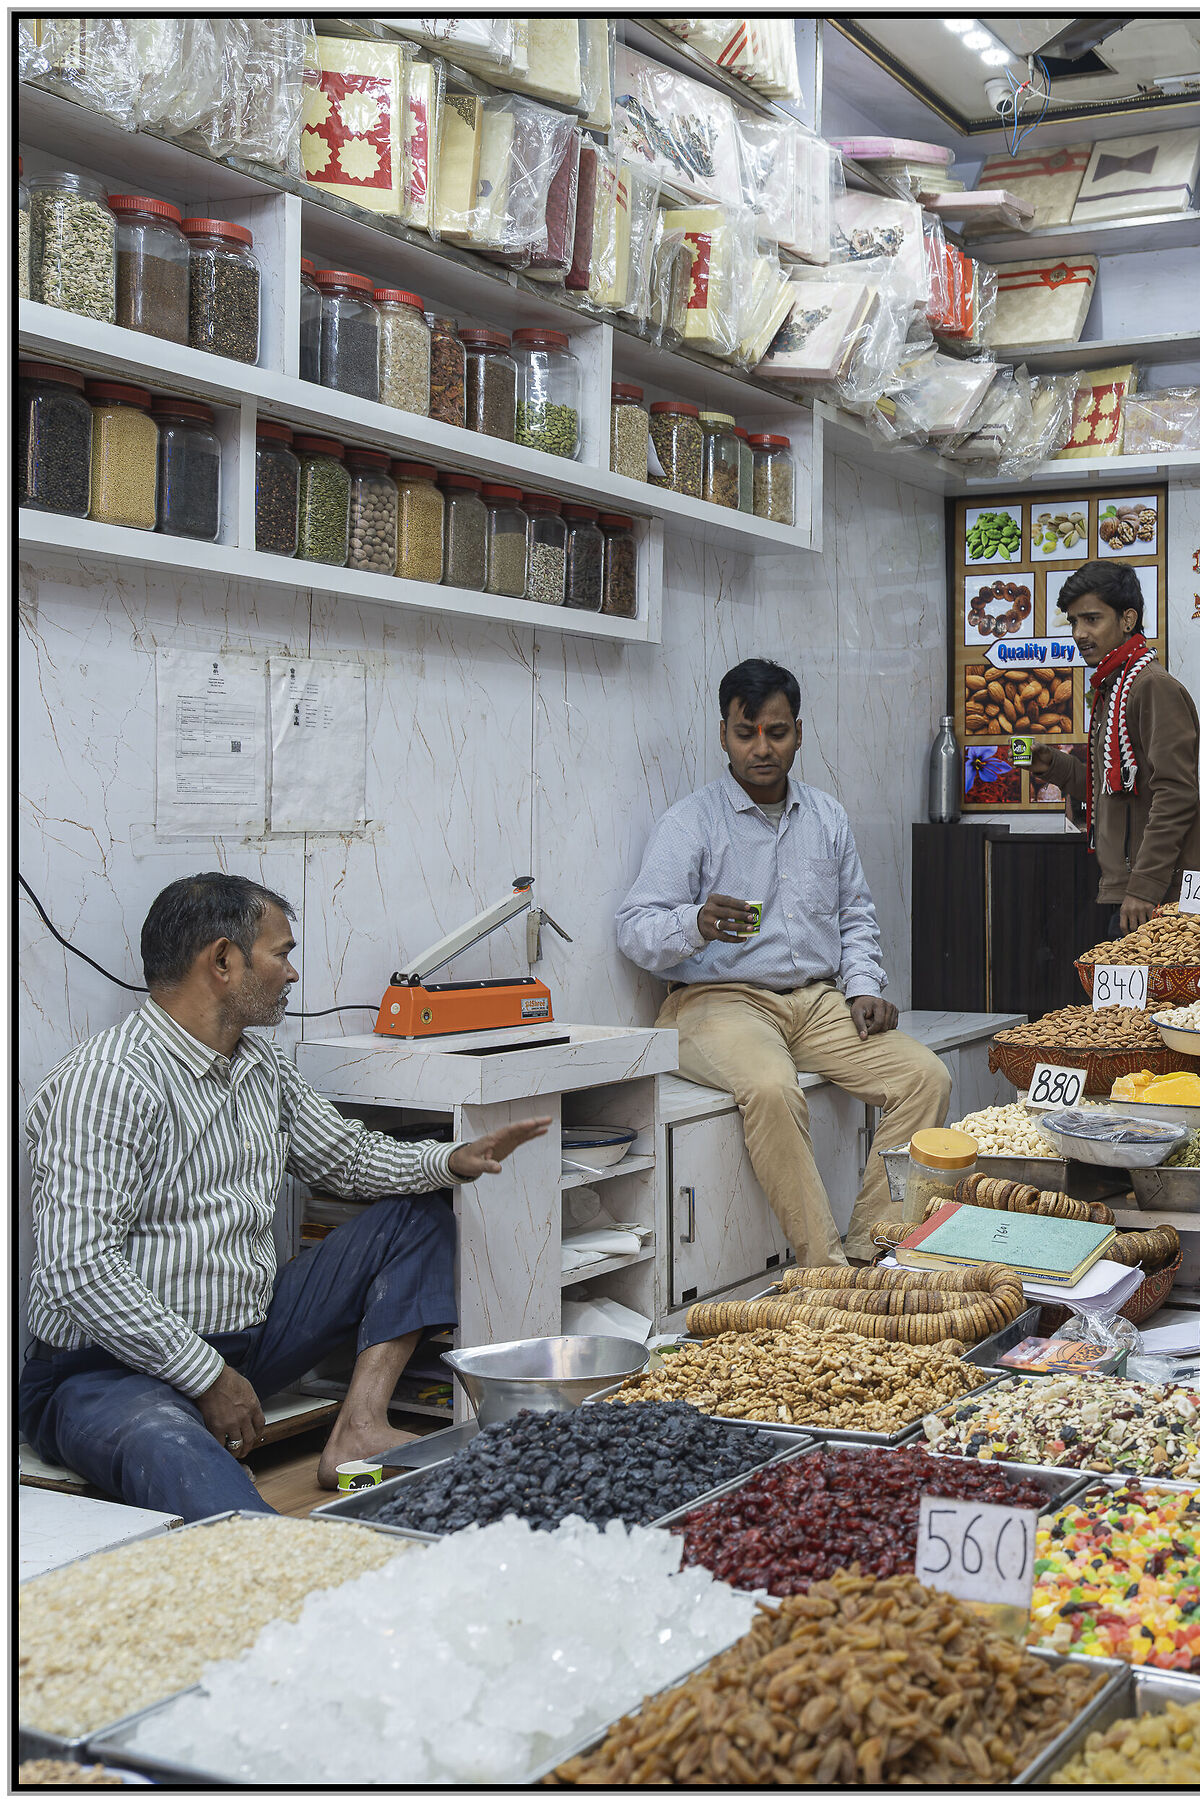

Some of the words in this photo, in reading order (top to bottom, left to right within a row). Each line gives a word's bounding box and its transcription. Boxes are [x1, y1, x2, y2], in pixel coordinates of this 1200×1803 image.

[997, 642, 1047, 663] Quality
[1050, 641, 1076, 662] Dry
[1031, 1068, 1081, 1107] 880
